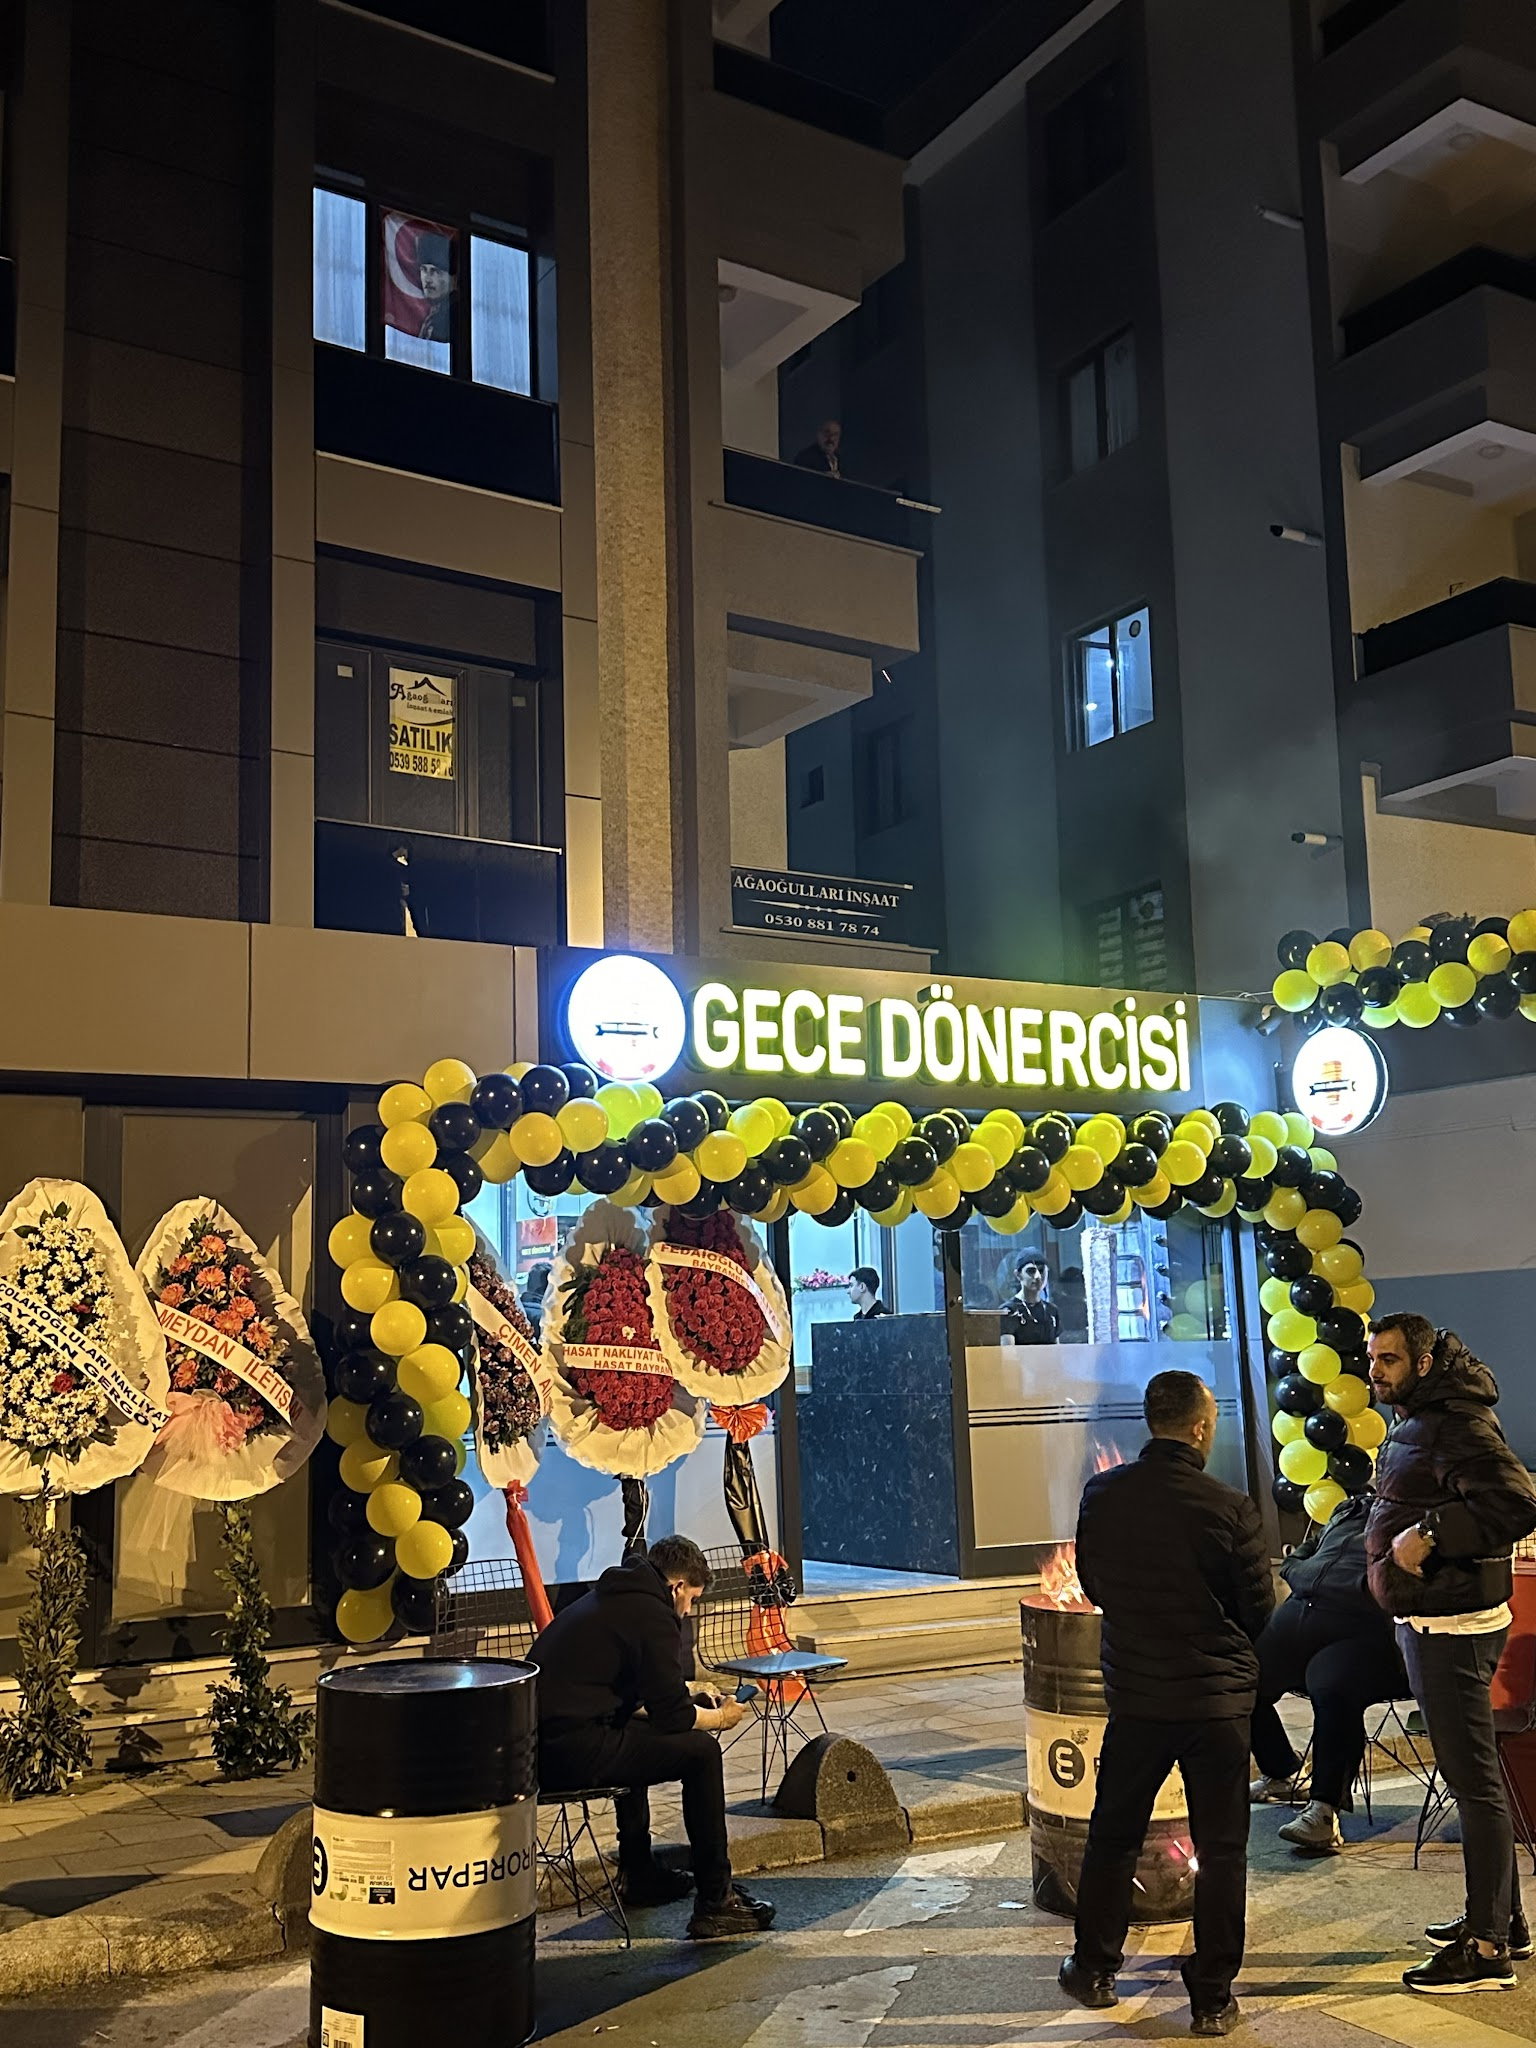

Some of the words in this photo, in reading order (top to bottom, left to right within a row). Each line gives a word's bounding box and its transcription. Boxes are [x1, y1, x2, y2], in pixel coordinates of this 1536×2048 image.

[389, 683, 453, 706] Ağaoğarı
[389, 724, 453, 753] SATILIK
[389, 751, 410, 770] 0539
[413, 756, 428, 773] 588
[733, 874, 844, 901] AĞAOĞULLARI
[847, 887, 899, 908] İNŞAAT
[765, 913, 803, 927] 0530
[807, 918, 834, 931] 881
[840, 922, 857, 933] 78
[862, 925, 879, 936] 74
[693, 982, 866, 1075] GECE
[880, 983, 1191, 1091] DÖNERCİSİ
[1, 1302, 78, 1360] AYHAN
[160, 1309, 235, 1360] MEYDAN
[563, 1346, 600, 1358] HASAT
[603, 1347, 654, 1361] NAKLİYAT
[593, 1360, 632, 1370] HASAT
[112, 1370, 171, 1423] NAKLİYAT
